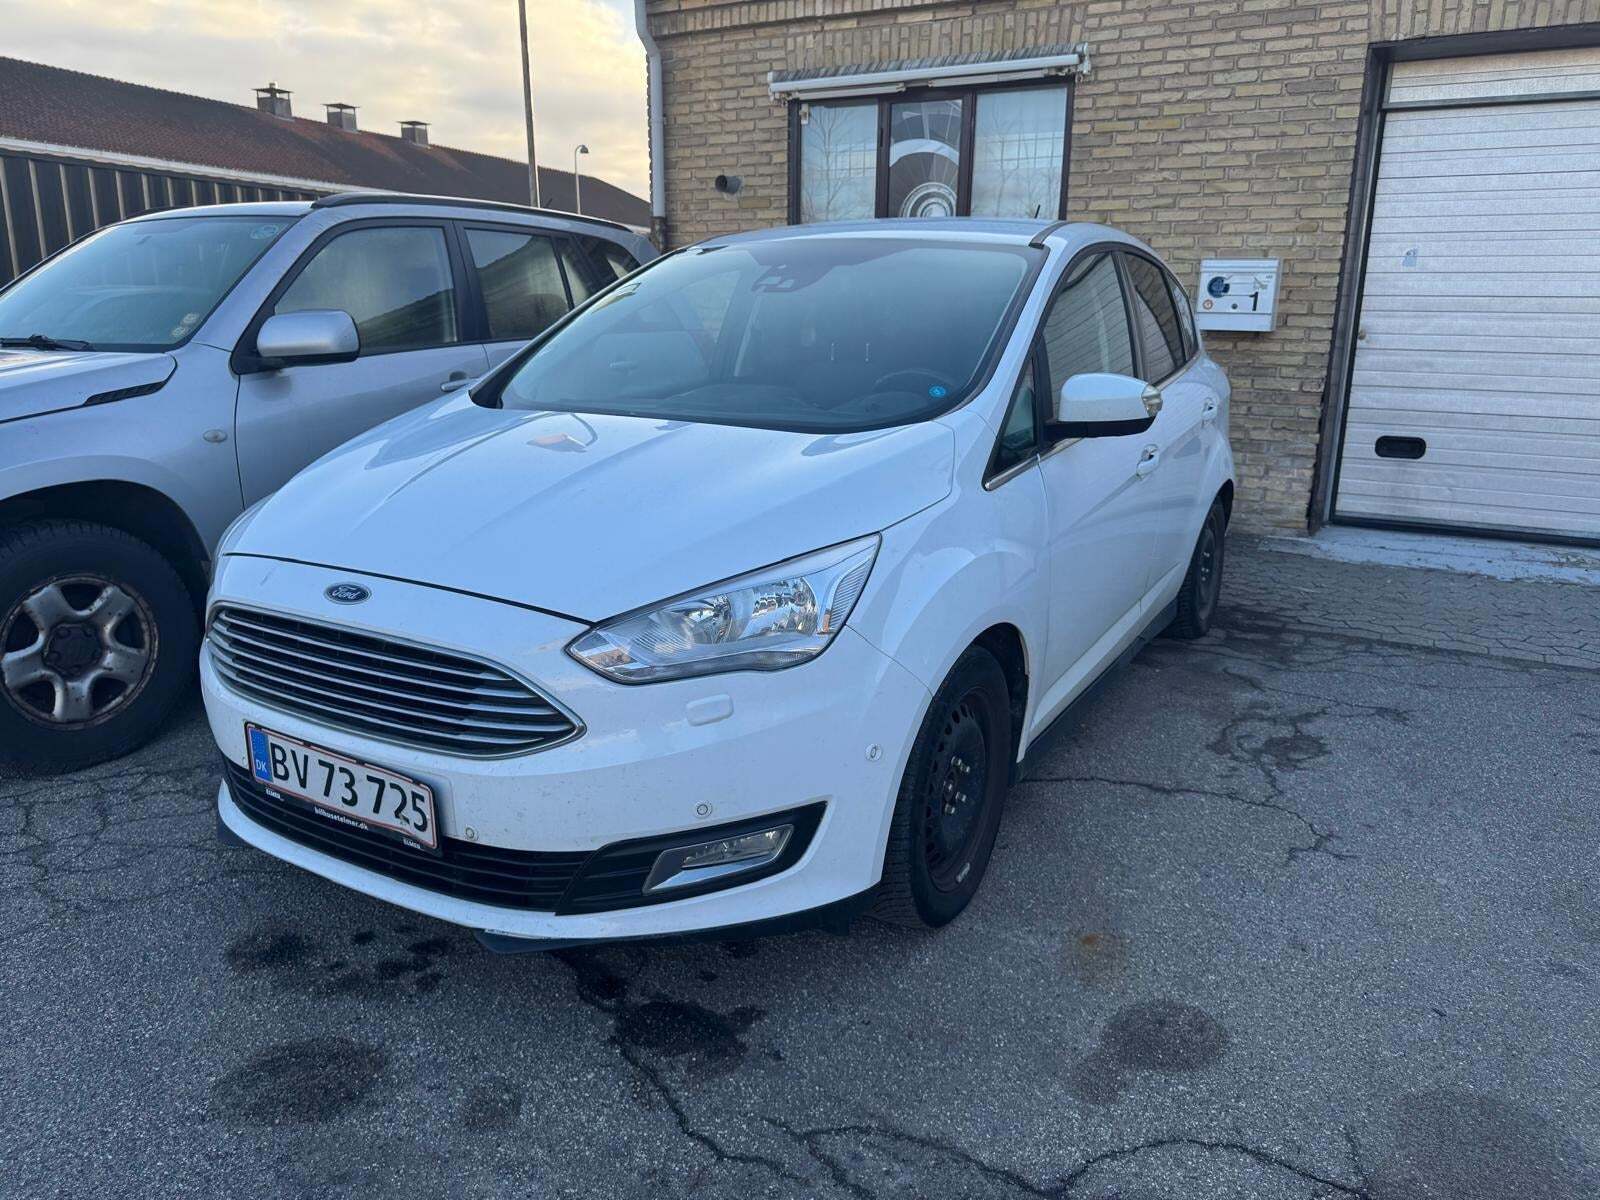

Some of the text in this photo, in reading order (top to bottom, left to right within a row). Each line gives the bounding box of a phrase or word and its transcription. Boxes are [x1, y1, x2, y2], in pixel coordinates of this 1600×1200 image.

[1249, 291, 1259, 311] 1
[331, 585, 361, 599] Ford
[255, 758, 267, 773] DK
[270, 742, 428, 832] BV 73 725
